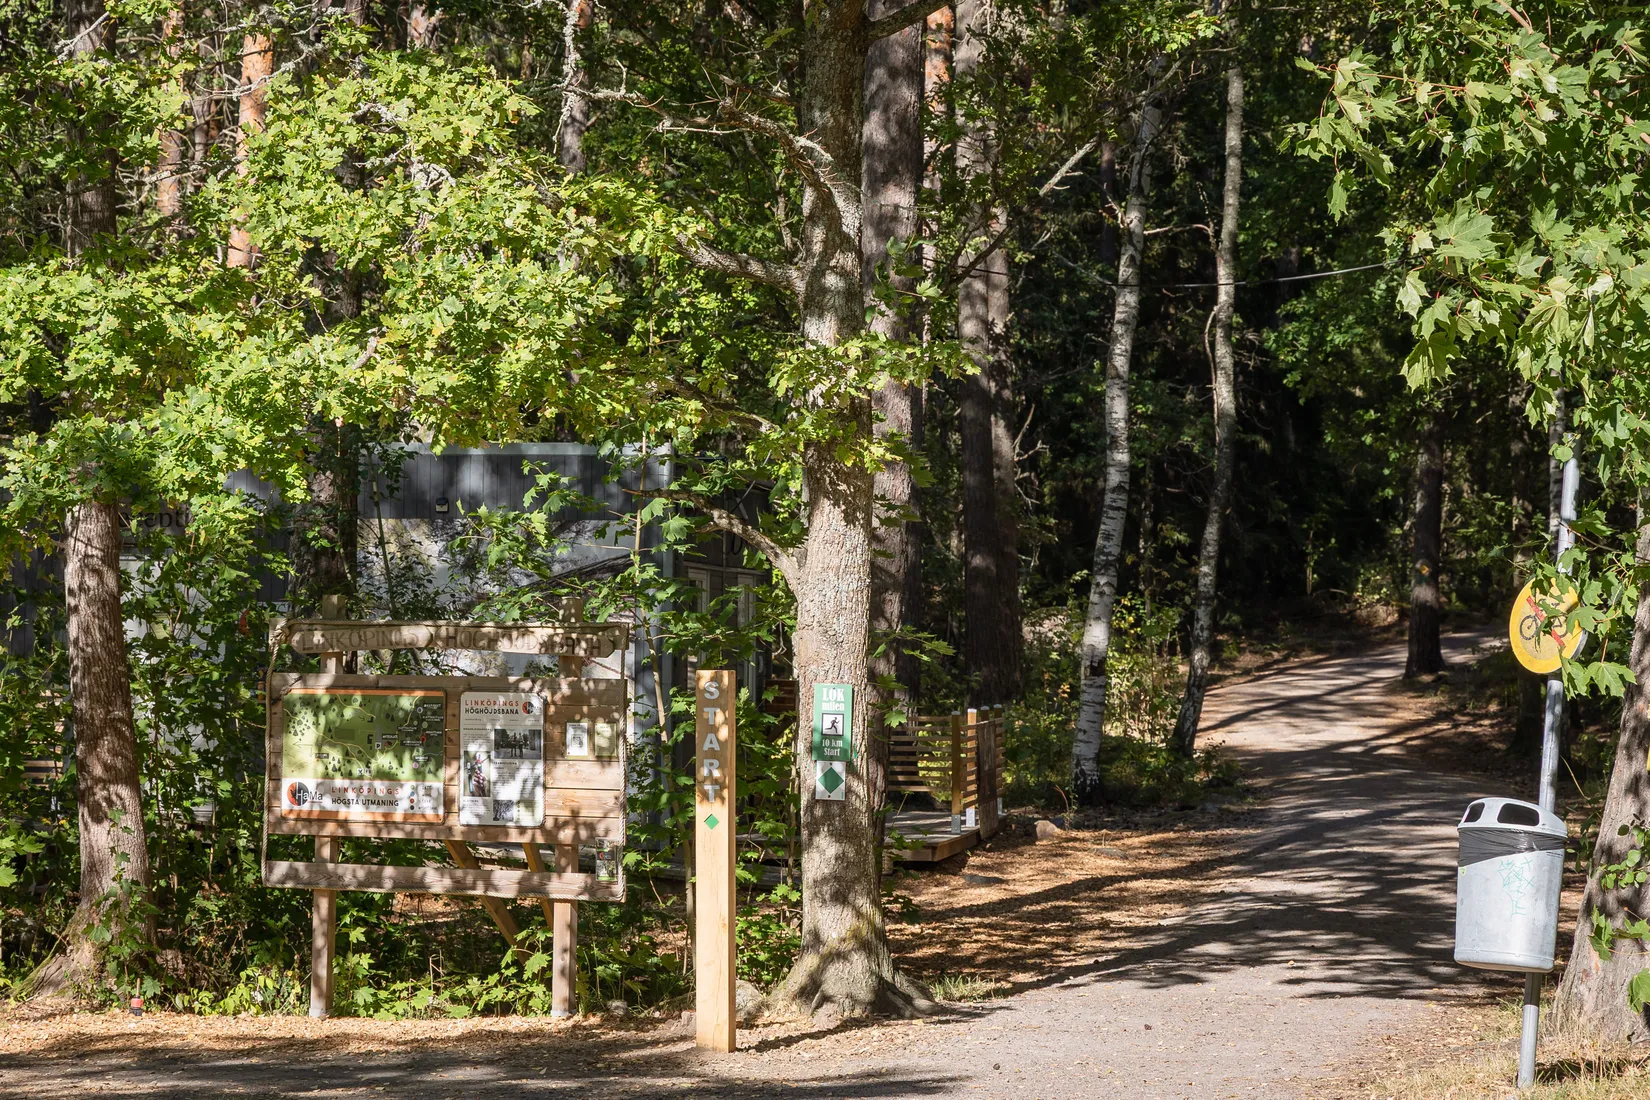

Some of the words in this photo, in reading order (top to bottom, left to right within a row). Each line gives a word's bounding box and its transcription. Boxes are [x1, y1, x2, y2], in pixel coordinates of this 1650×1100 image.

[823, 688, 844, 701] LOK
[822, 702, 844, 711] milen
[703, 682, 720, 802] START
[822, 739, 830, 748] 10
[832, 738, 843, 748] km
[824, 748, 840, 756] Start
[296, 782, 323, 804] HaMa
[331, 786, 400, 796] LINKÖPINGS
[331, 798, 360, 806] HÖGSTA
[361, 799, 400, 807] UTMANING
